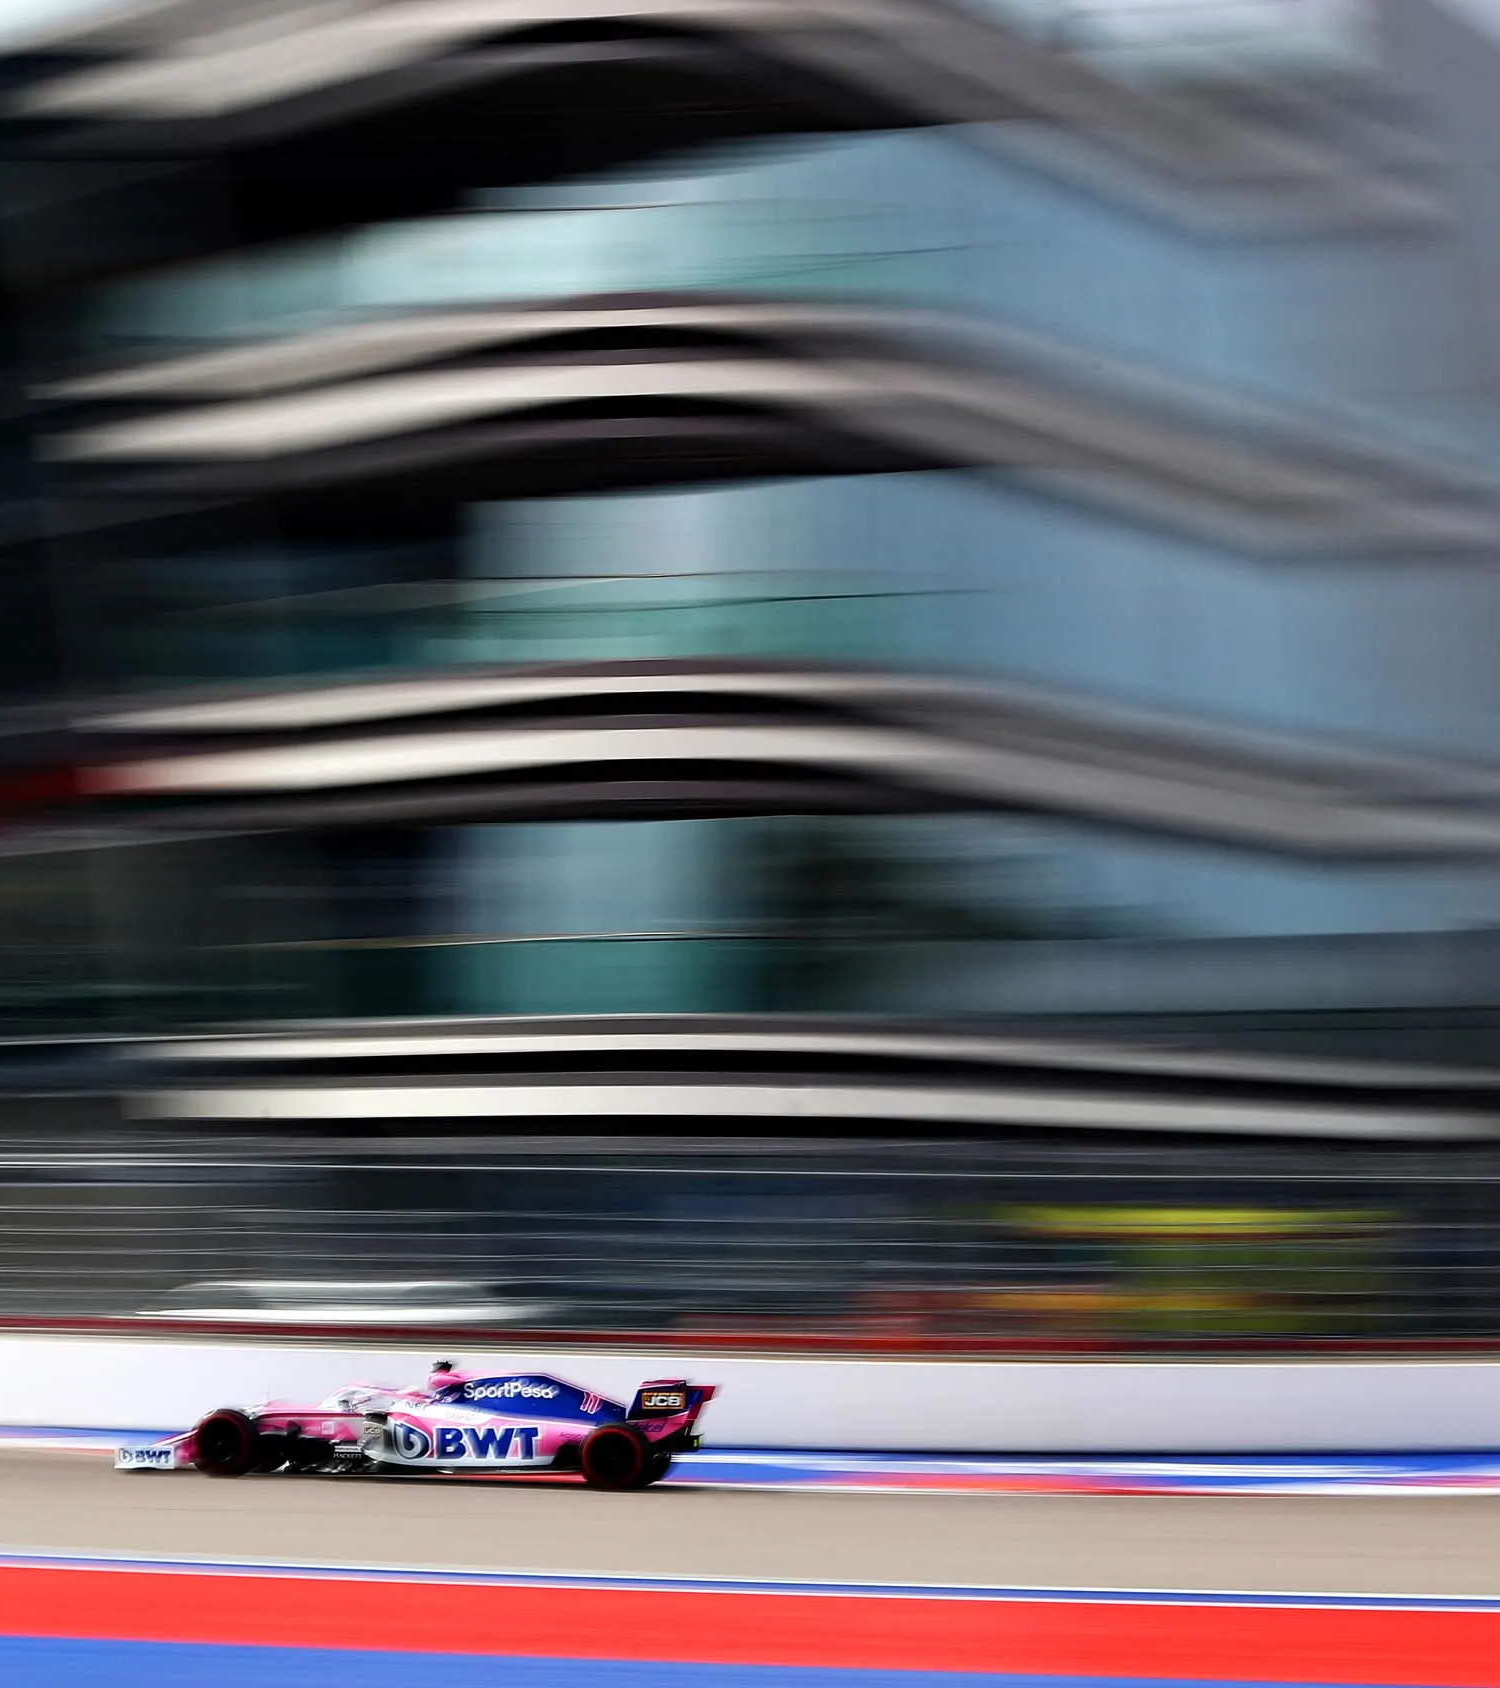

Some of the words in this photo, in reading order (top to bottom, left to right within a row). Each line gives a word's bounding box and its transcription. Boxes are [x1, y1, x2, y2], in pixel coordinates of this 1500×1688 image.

[464, 1382, 554, 1401] SportPesa
[644, 1395, 682, 1407] JCB
[435, 1426, 539, 1460] BWT
[135, 1450, 171, 1463] BWT
